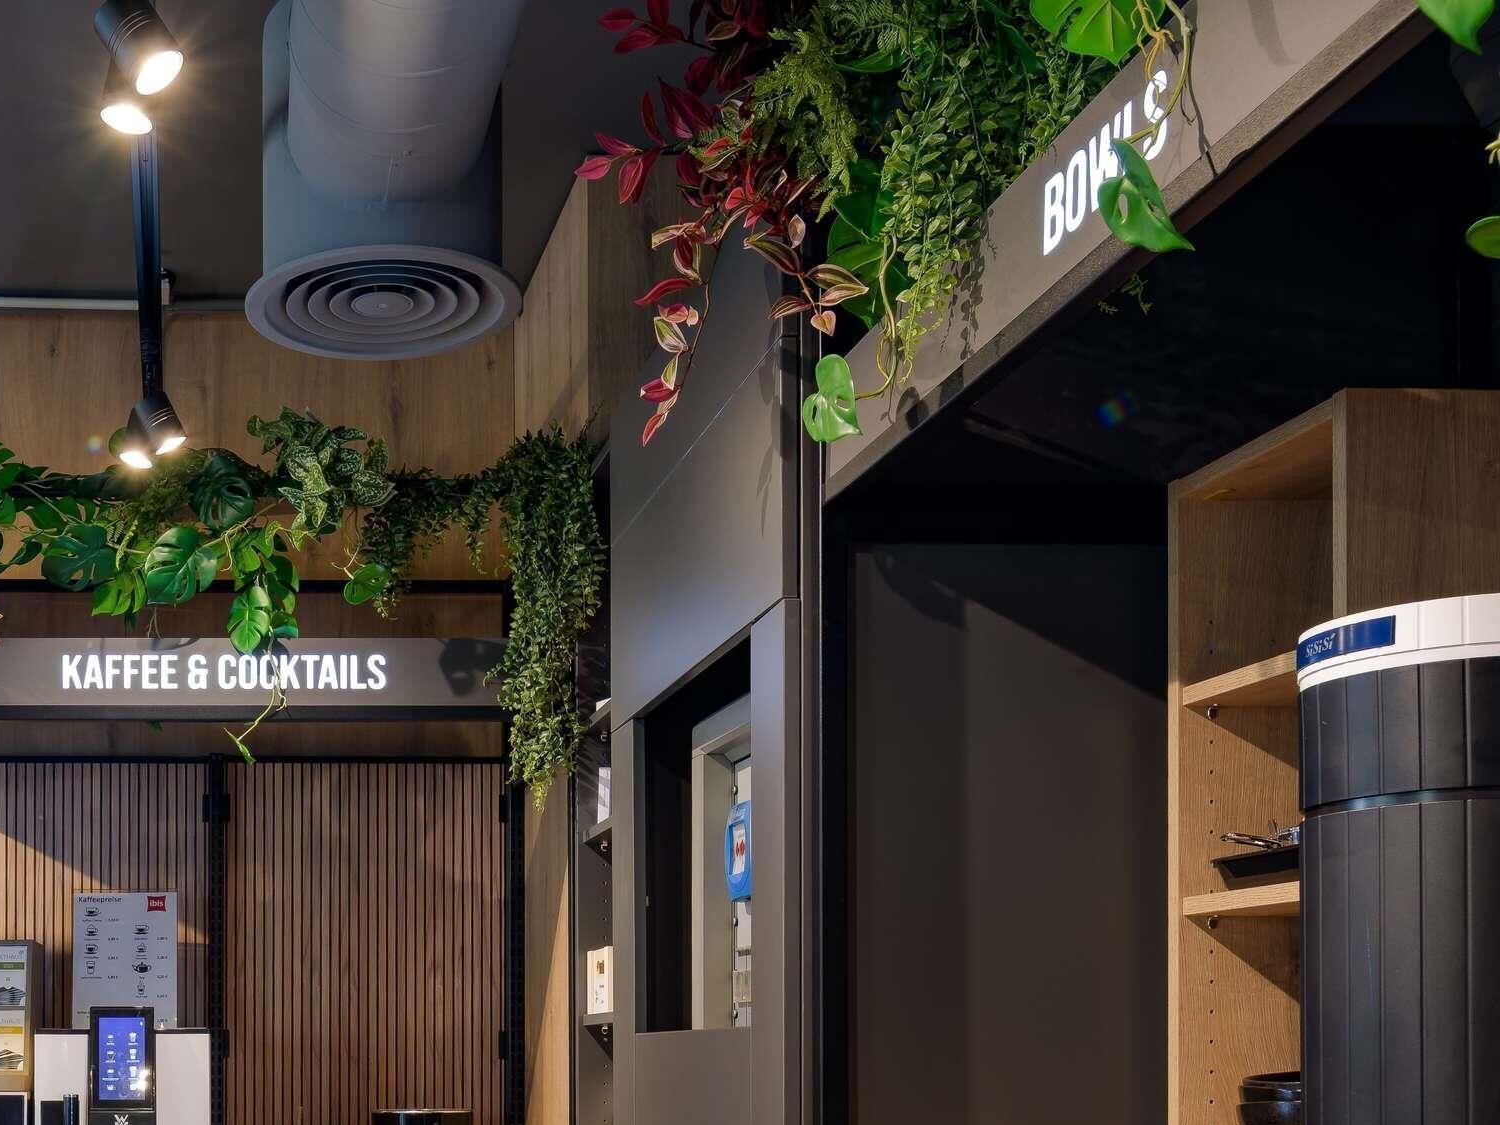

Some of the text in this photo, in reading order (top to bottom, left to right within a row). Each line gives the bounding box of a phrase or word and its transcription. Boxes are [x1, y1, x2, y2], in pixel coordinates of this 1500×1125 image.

[62, 654, 387, 690] KAFFEE & COCKTAILS
[149, 899, 164, 907] ibis
